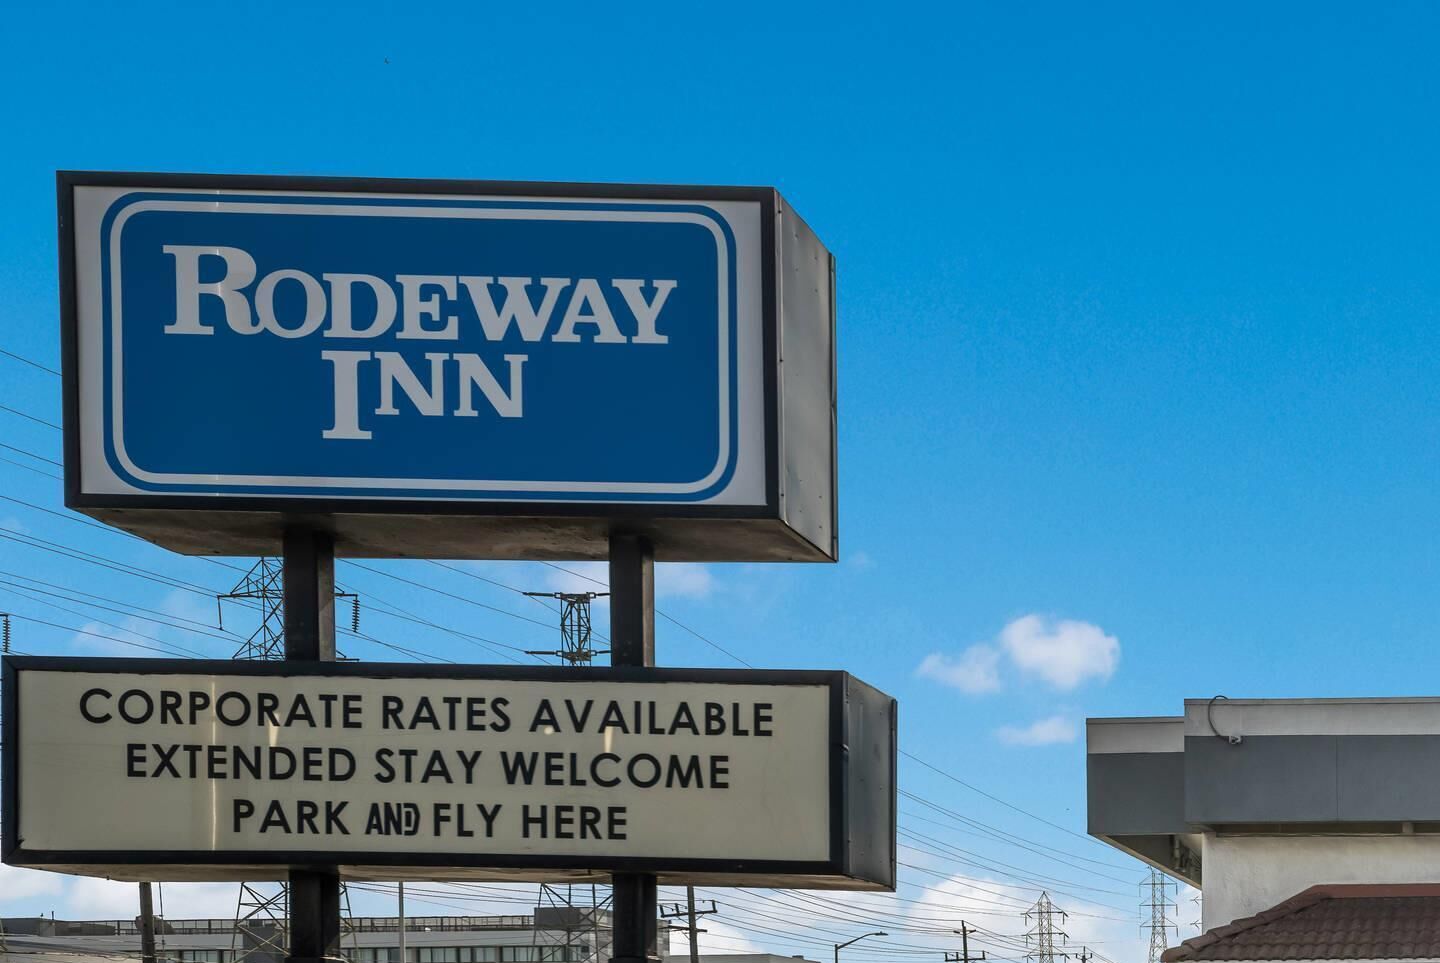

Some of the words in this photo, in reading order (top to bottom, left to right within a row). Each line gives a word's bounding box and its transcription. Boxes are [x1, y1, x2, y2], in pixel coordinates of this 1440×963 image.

[163, 245, 677, 345] RODEWAY
[321, 350, 528, 440] INN
[78, 687, 363, 730] CORPORATE
[381, 695, 512, 733] RATES
[528, 698, 774, 738] AVAILABLE
[126, 742, 357, 783] EXTENDED
[373, 747, 483, 786] STAY
[499, 750, 730, 790] WELCOME
[232, 798, 352, 836] PARK
[364, 801, 422, 838] AND
[432, 802, 503, 839] FLY
[521, 804, 628, 841] HERE
